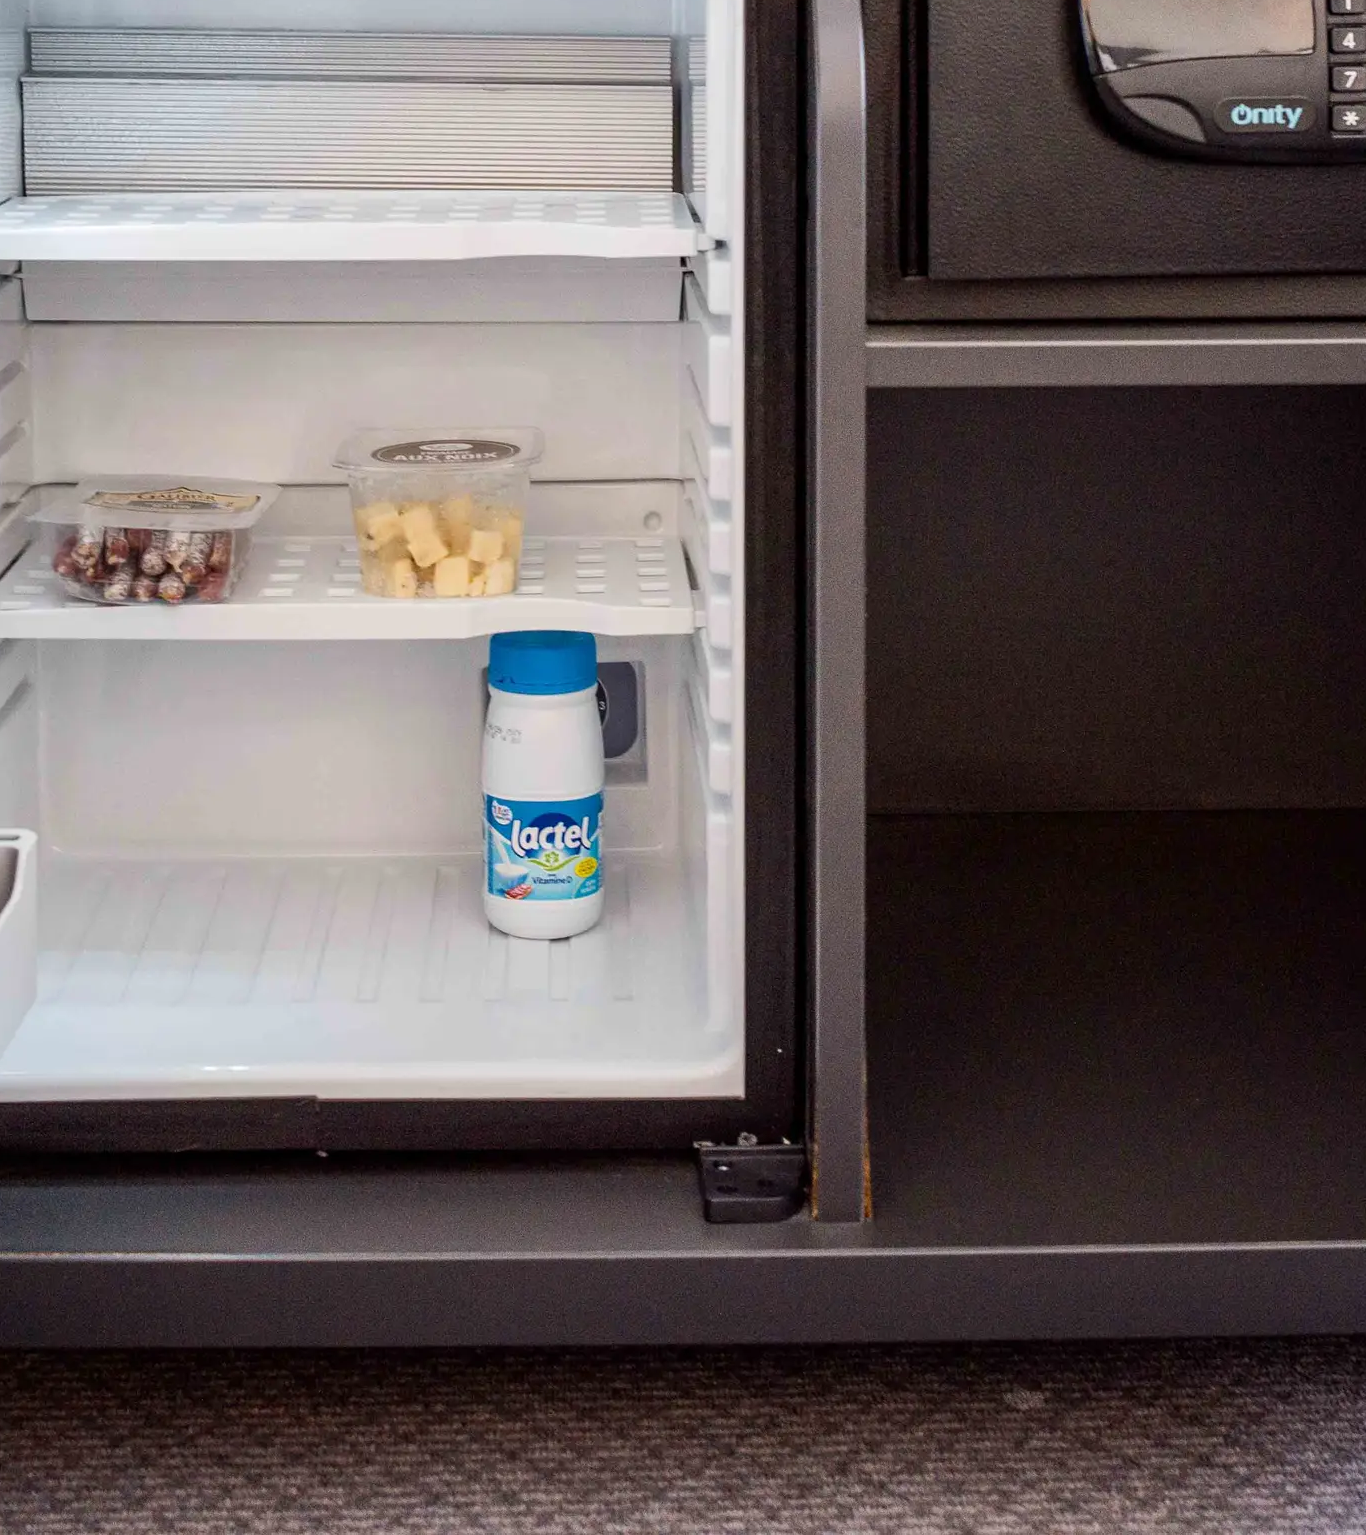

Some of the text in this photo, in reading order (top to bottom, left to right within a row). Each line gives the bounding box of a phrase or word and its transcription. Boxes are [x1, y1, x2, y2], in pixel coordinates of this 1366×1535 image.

[1342, 32, 1356, 49] 4
[1343, 71, 1357, 88] 7
[1231, 104, 1303, 129] Onity
[446, 452, 497, 460] NOIX
[511, 816, 591, 858] lactel
